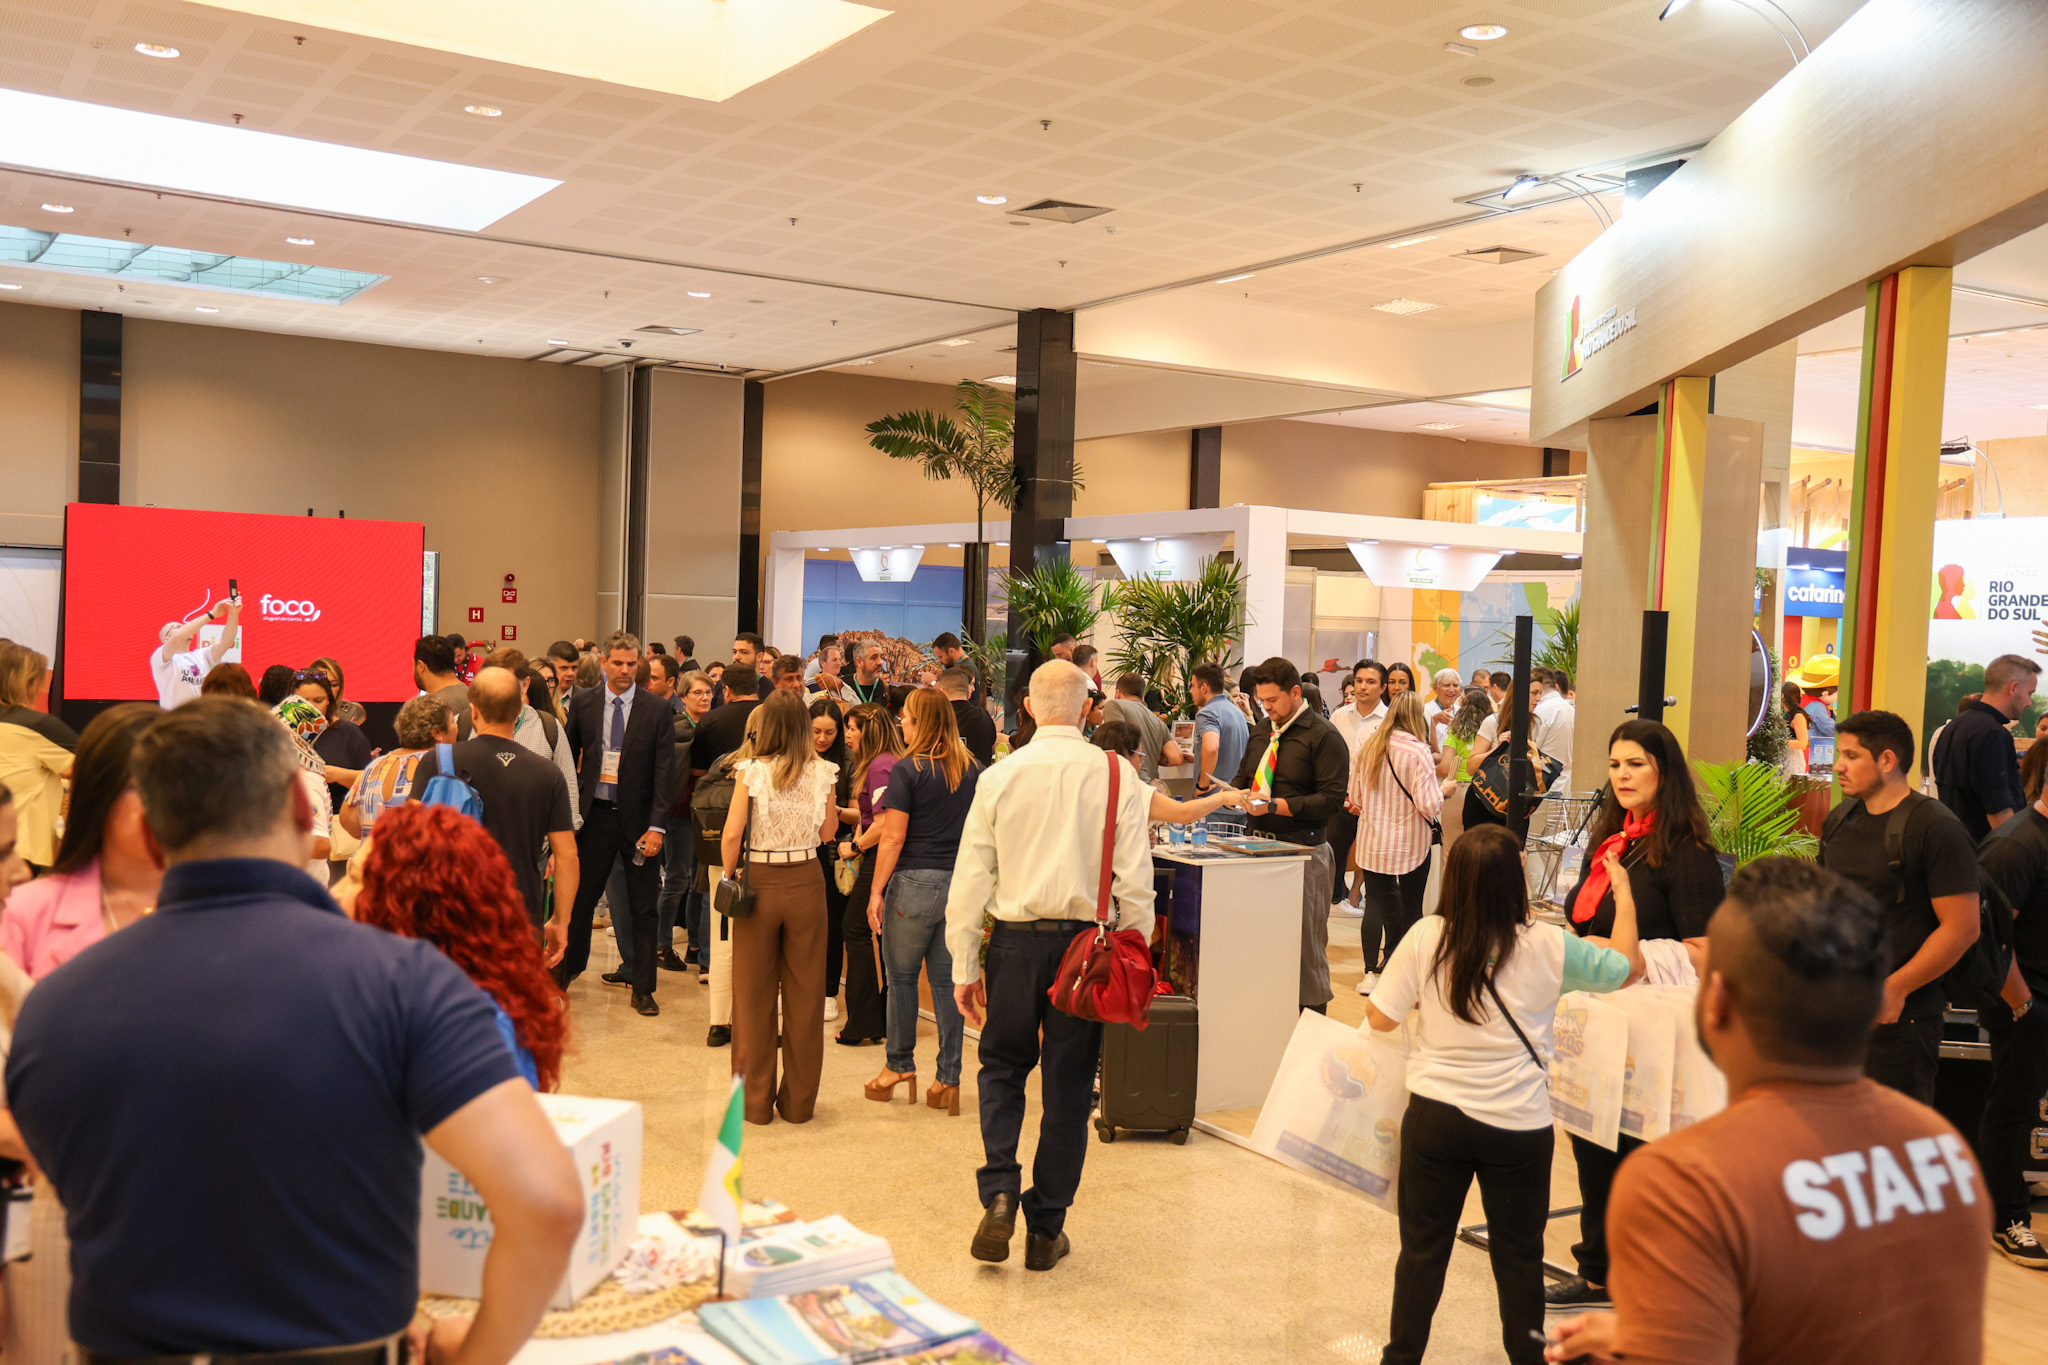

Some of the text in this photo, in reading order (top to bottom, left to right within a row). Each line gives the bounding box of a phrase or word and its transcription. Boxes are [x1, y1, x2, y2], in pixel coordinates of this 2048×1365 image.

[1787, 583, 1845, 604] catarin
[1989, 581, 2014, 593] RIO
[260, 594, 315, 616] foco
[1988, 594, 2048, 607] GRANDE
[472, 610, 480, 620] H
[1988, 608, 2041, 620] DO SUL
[1783, 1133, 1976, 1240] STAFF
